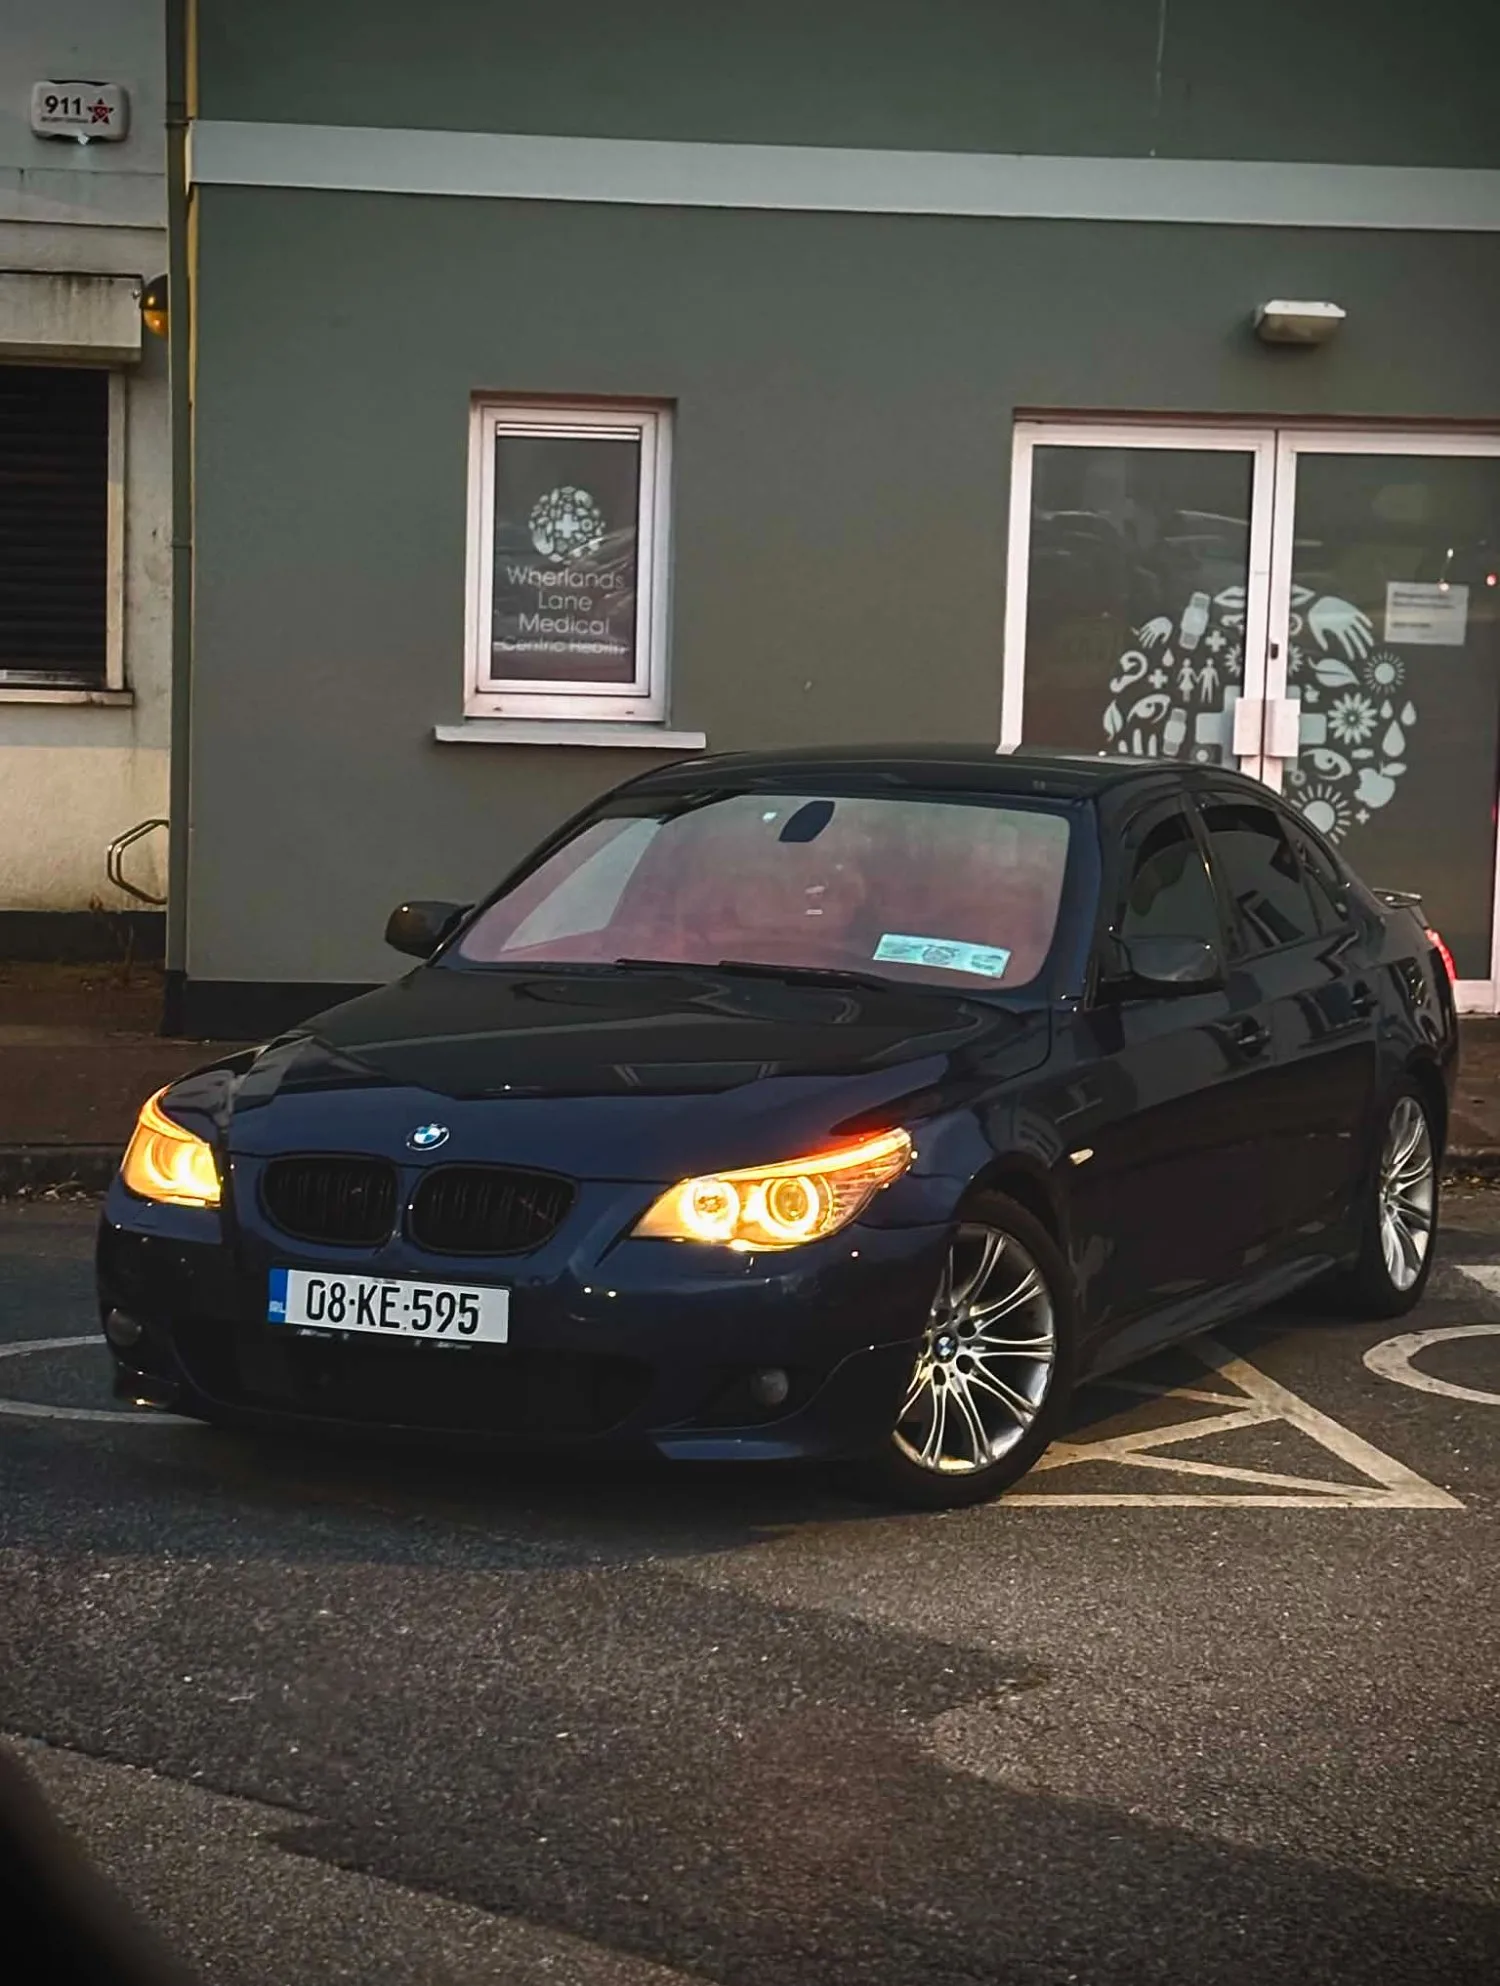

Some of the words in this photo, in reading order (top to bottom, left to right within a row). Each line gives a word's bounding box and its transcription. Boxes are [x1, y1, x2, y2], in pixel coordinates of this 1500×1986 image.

[44, 94, 82, 115] 911
[538, 590, 593, 612] Lane
[519, 612, 611, 635] Medical
